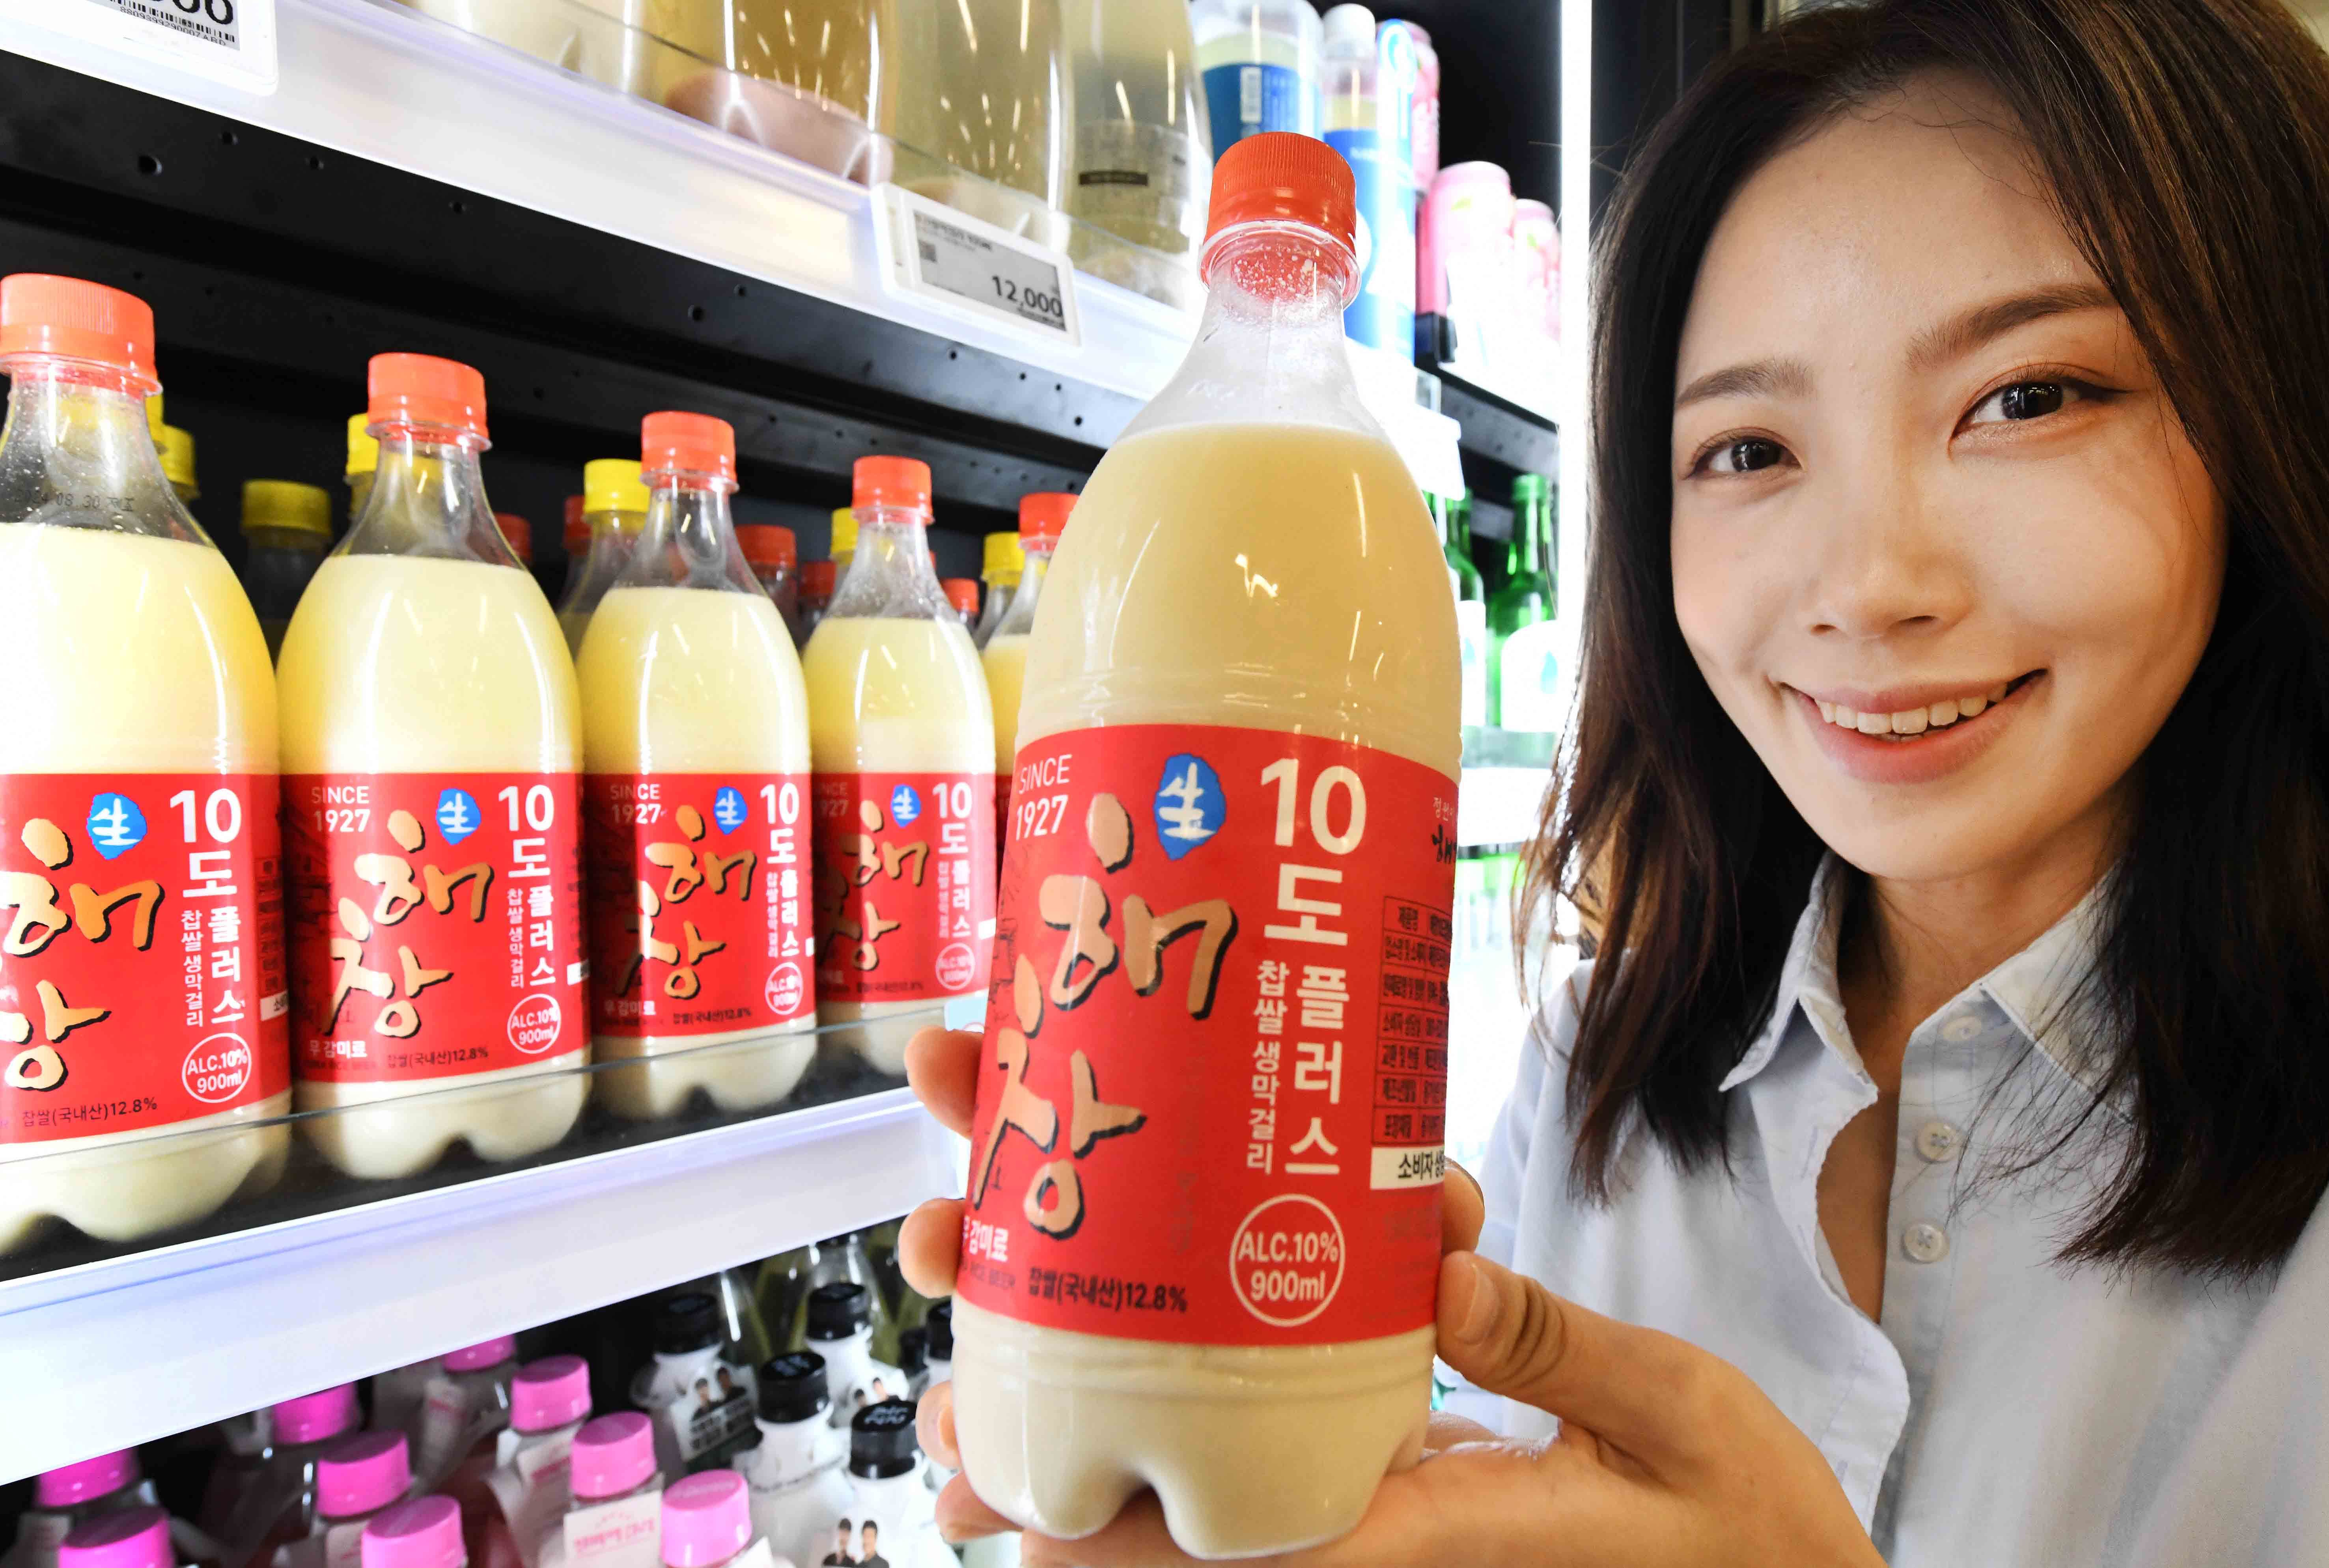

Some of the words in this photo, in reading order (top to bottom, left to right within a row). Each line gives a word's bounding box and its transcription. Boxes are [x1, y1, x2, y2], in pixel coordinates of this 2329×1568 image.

[992, 275, 1063, 318] 12,000
[1019, 753, 1073, 795] SINCE
[311, 786, 370, 804] SINCE
[610, 783, 661, 800] SINCE
[315, 808, 371, 833] 1927
[611, 803, 661, 825] 1927
[1015, 794, 1069, 842] 1927
[187, 1048, 248, 1076] ALC.10%
[197, 1069, 243, 1094] 900ml
[1238, 1231, 1339, 1262] ALC.10%
[1250, 1269, 1326, 1302] 900ml
